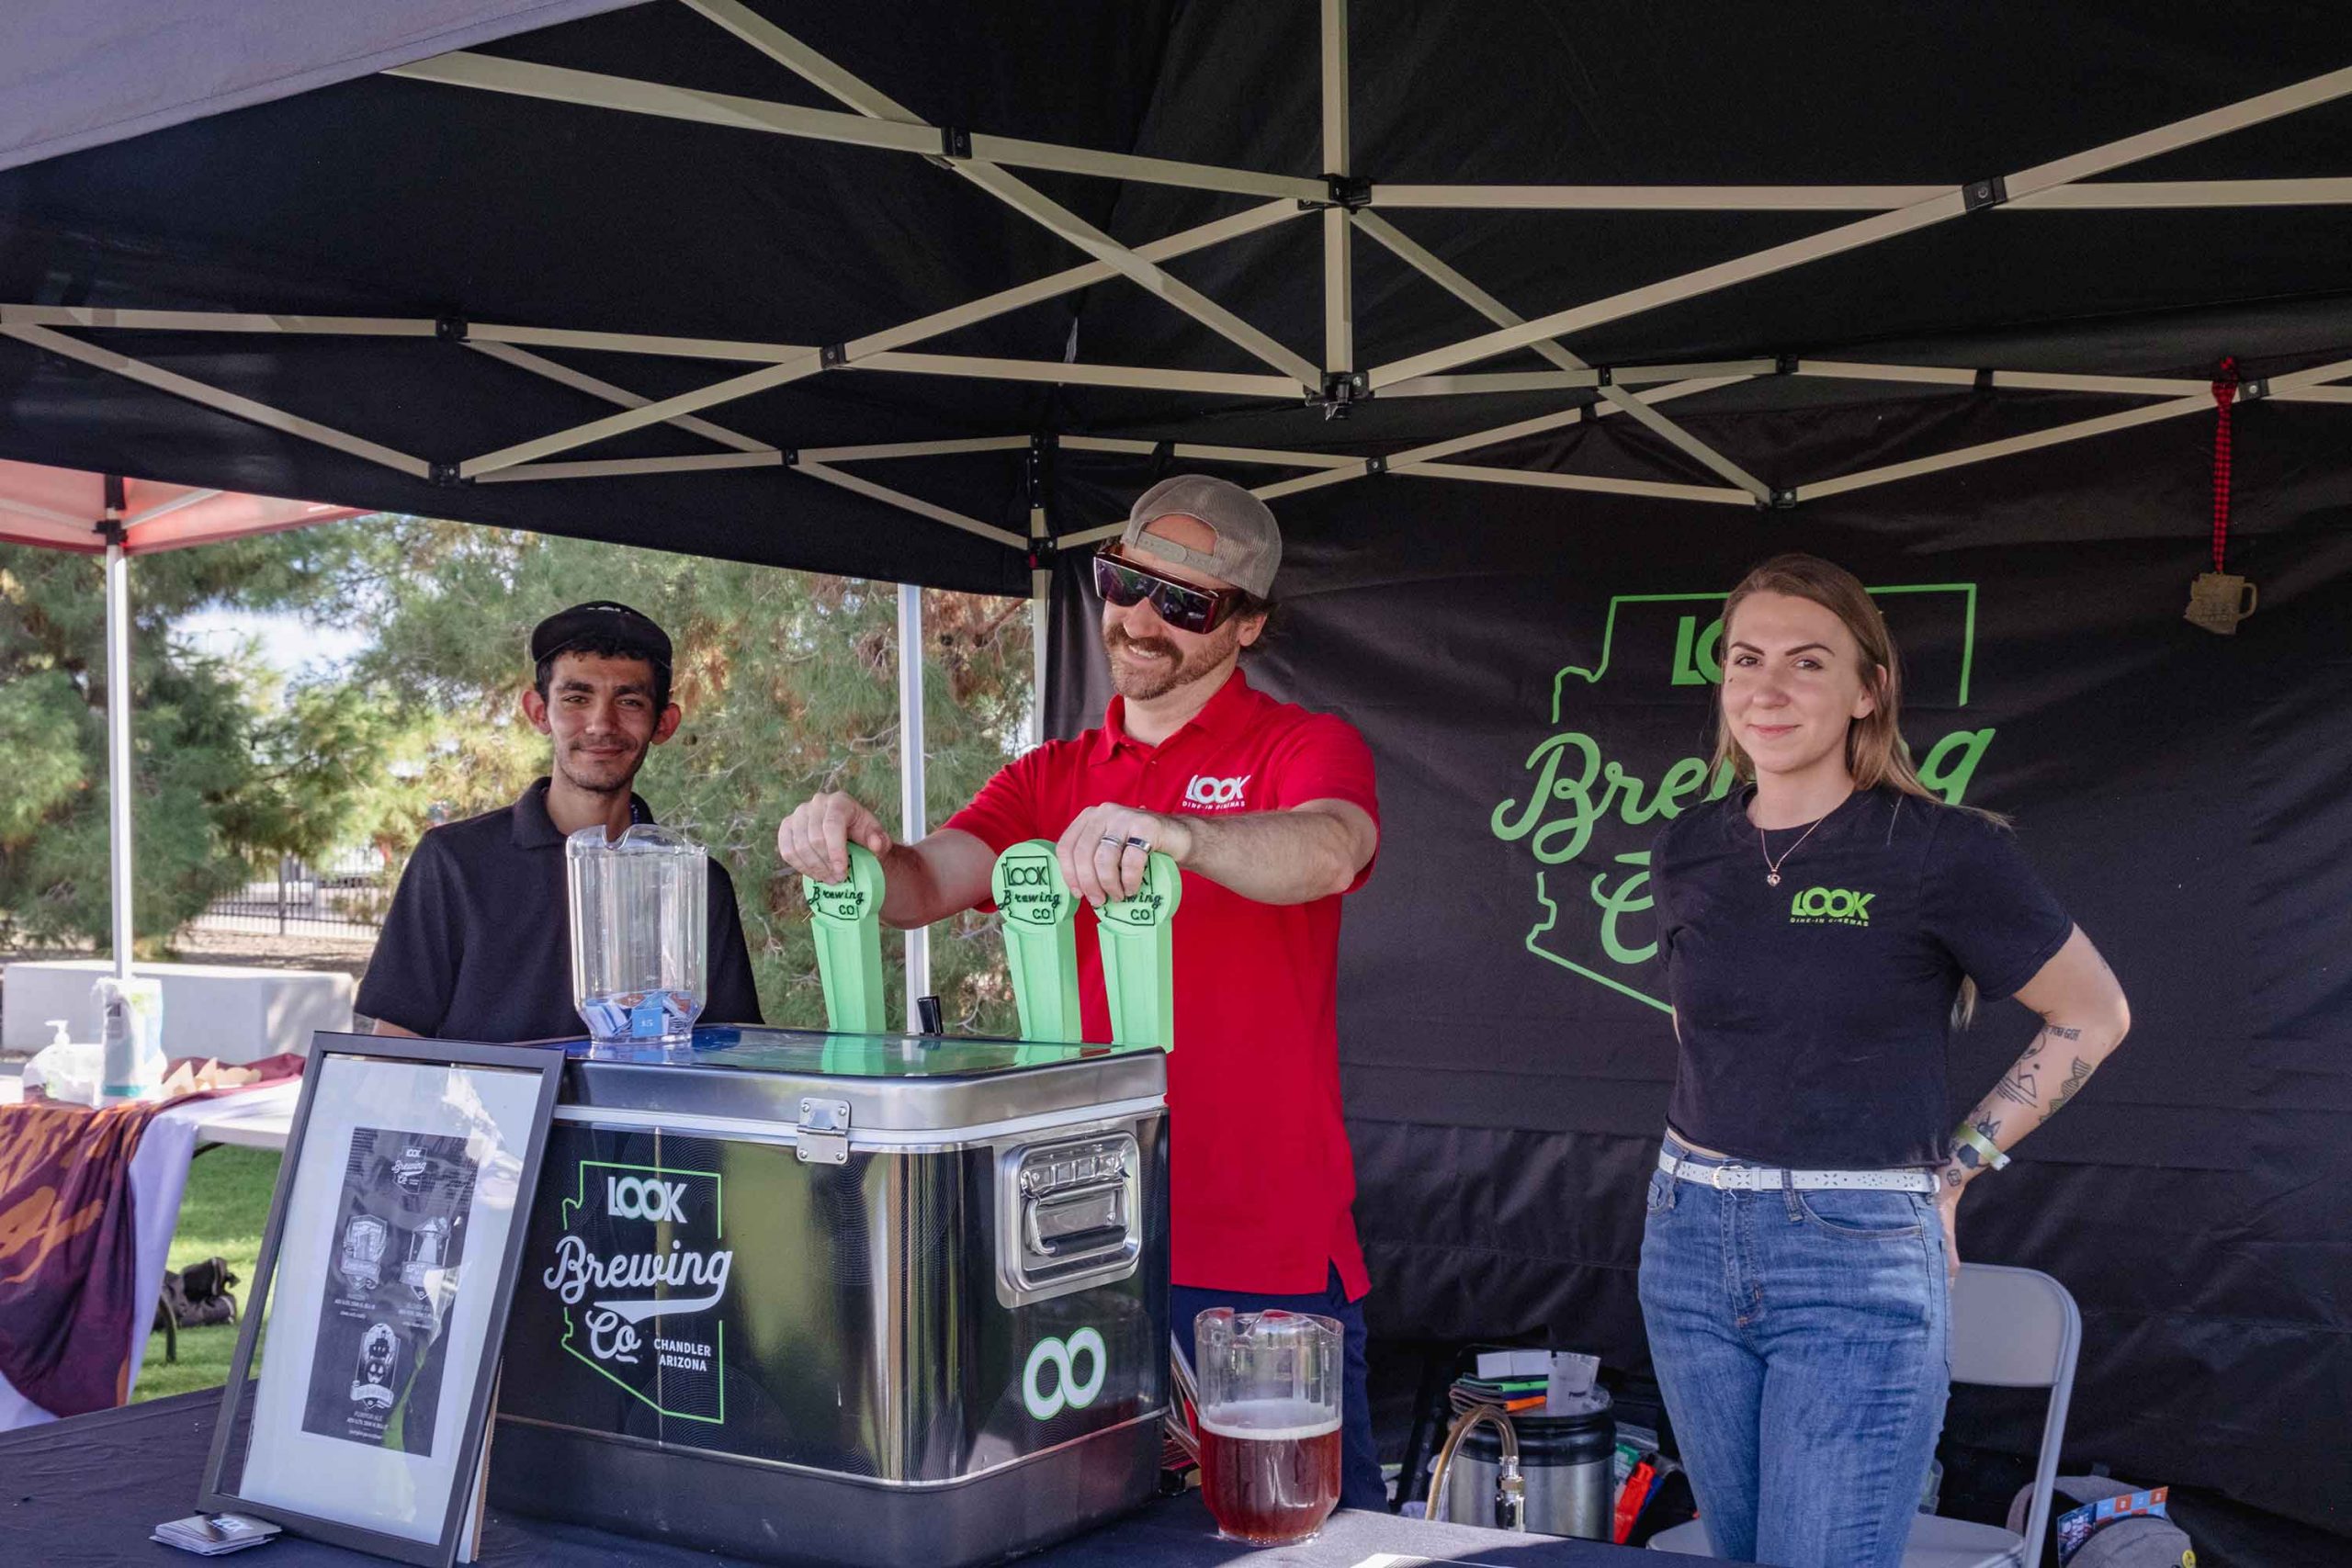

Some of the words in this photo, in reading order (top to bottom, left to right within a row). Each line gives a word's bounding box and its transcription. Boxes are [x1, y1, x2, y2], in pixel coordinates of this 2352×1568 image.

[1671, 615, 1724, 685] LO
[1185, 774, 1251, 804] LOOK
[1007, 866, 1047, 886] LOOK
[808, 886, 865, 906] Brewing
[997, 889, 1060, 909] Brewing
[1791, 886, 1875, 919] LOOK
[838, 904, 855, 916] CO
[1032, 908, 1051, 919] CO
[1130, 908, 1150, 920] CO
[607, 1176, 688, 1224] LOOK
[544, 1235, 733, 1324] Brewing
[585, 1311, 641, 1363] Co
[653, 1337, 712, 1358] CHANDLER
[659, 1353, 707, 1372] ARIZONA
